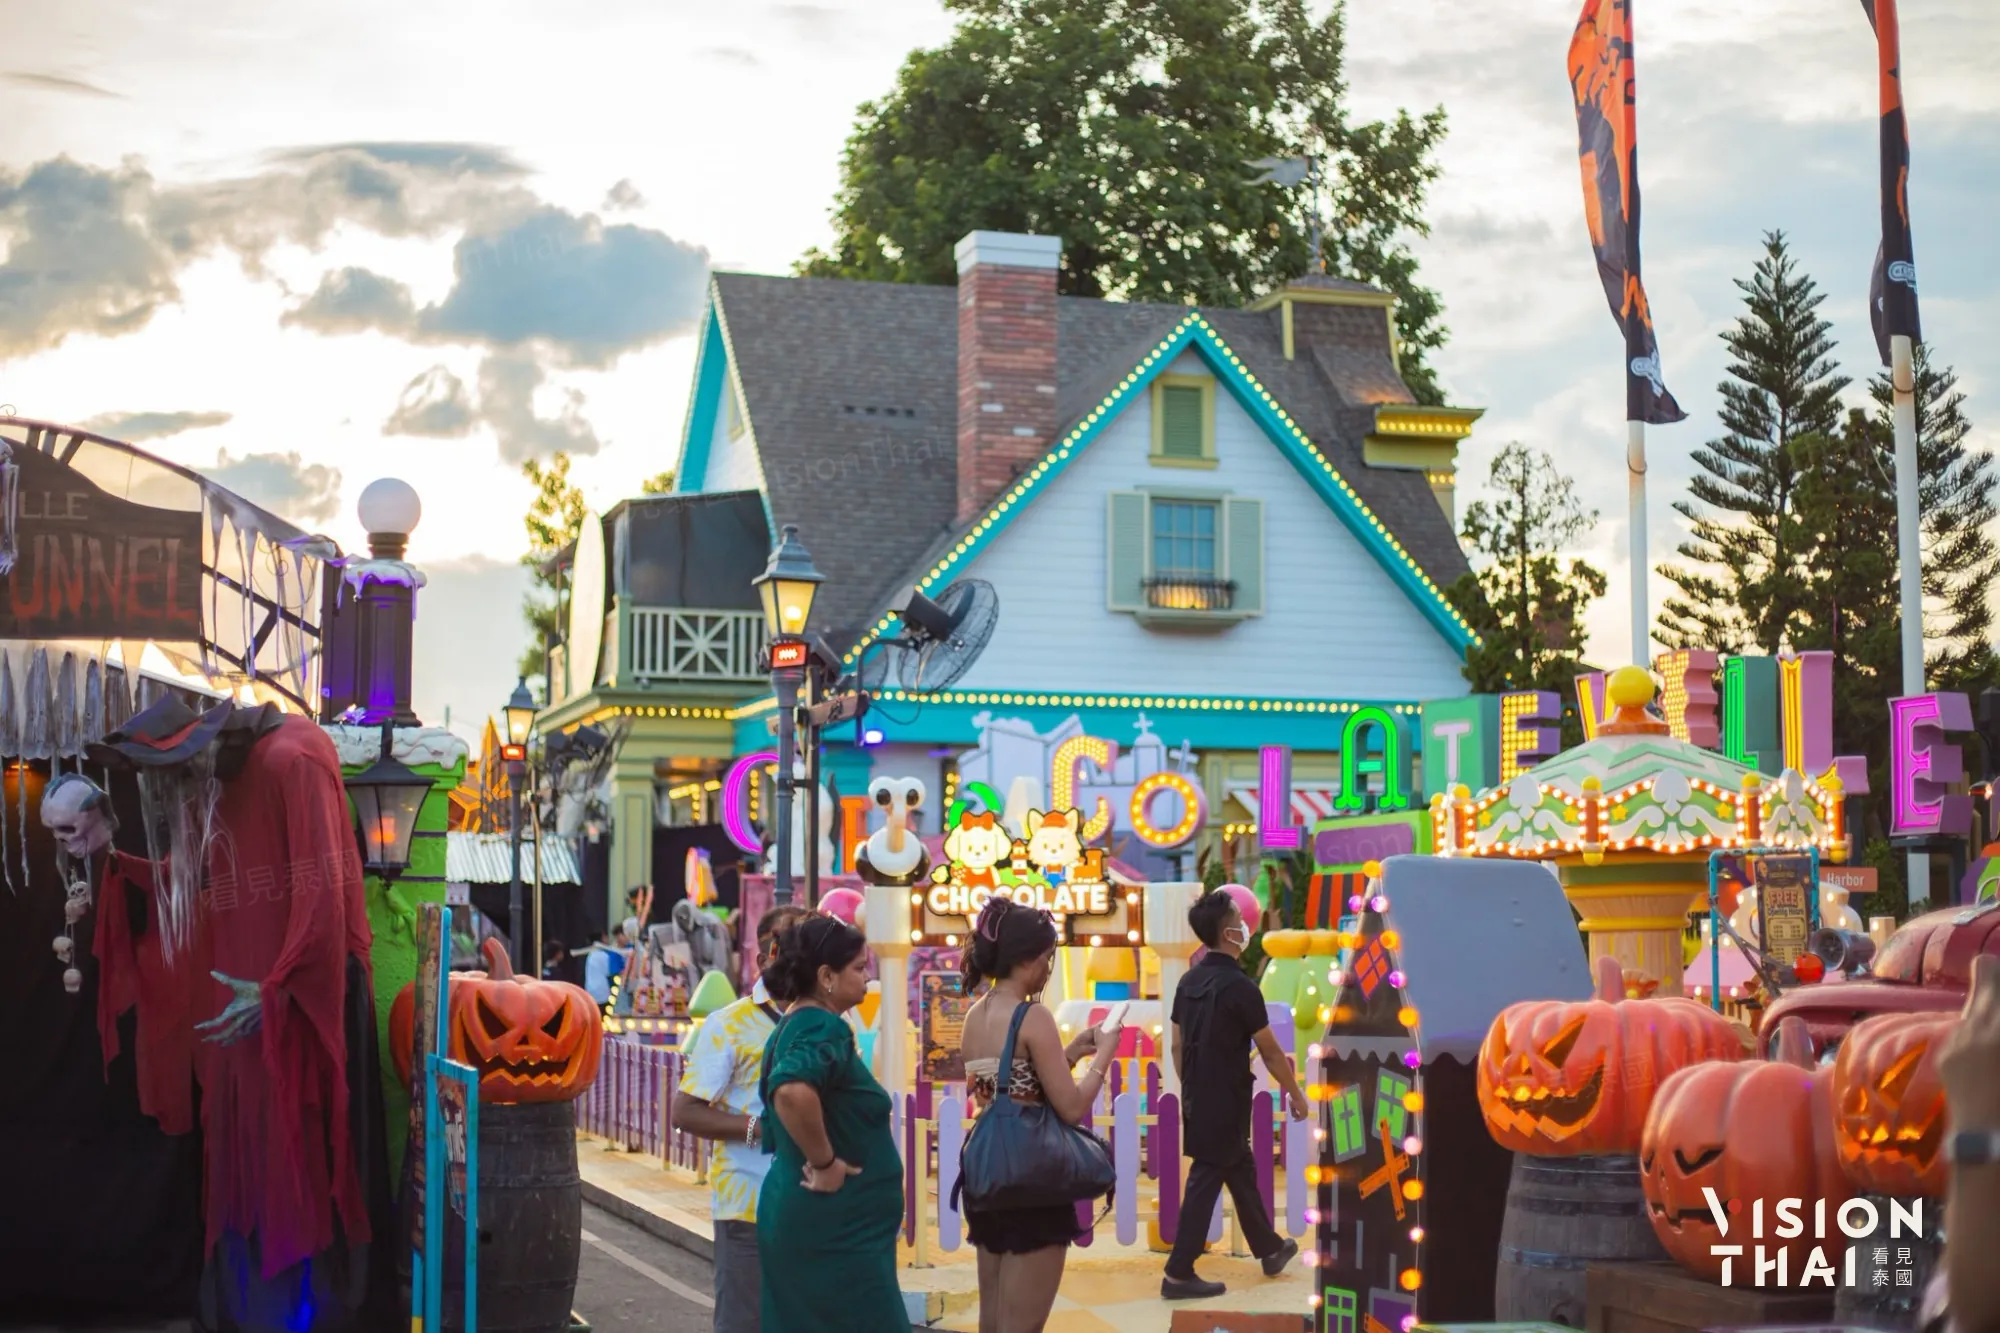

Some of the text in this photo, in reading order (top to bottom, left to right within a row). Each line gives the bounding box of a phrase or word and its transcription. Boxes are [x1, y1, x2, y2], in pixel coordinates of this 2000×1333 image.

[8, 533, 198, 621] UNNEL
[1827, 872, 1865, 886] Harbor
[1769, 890, 1798, 907] FREE
